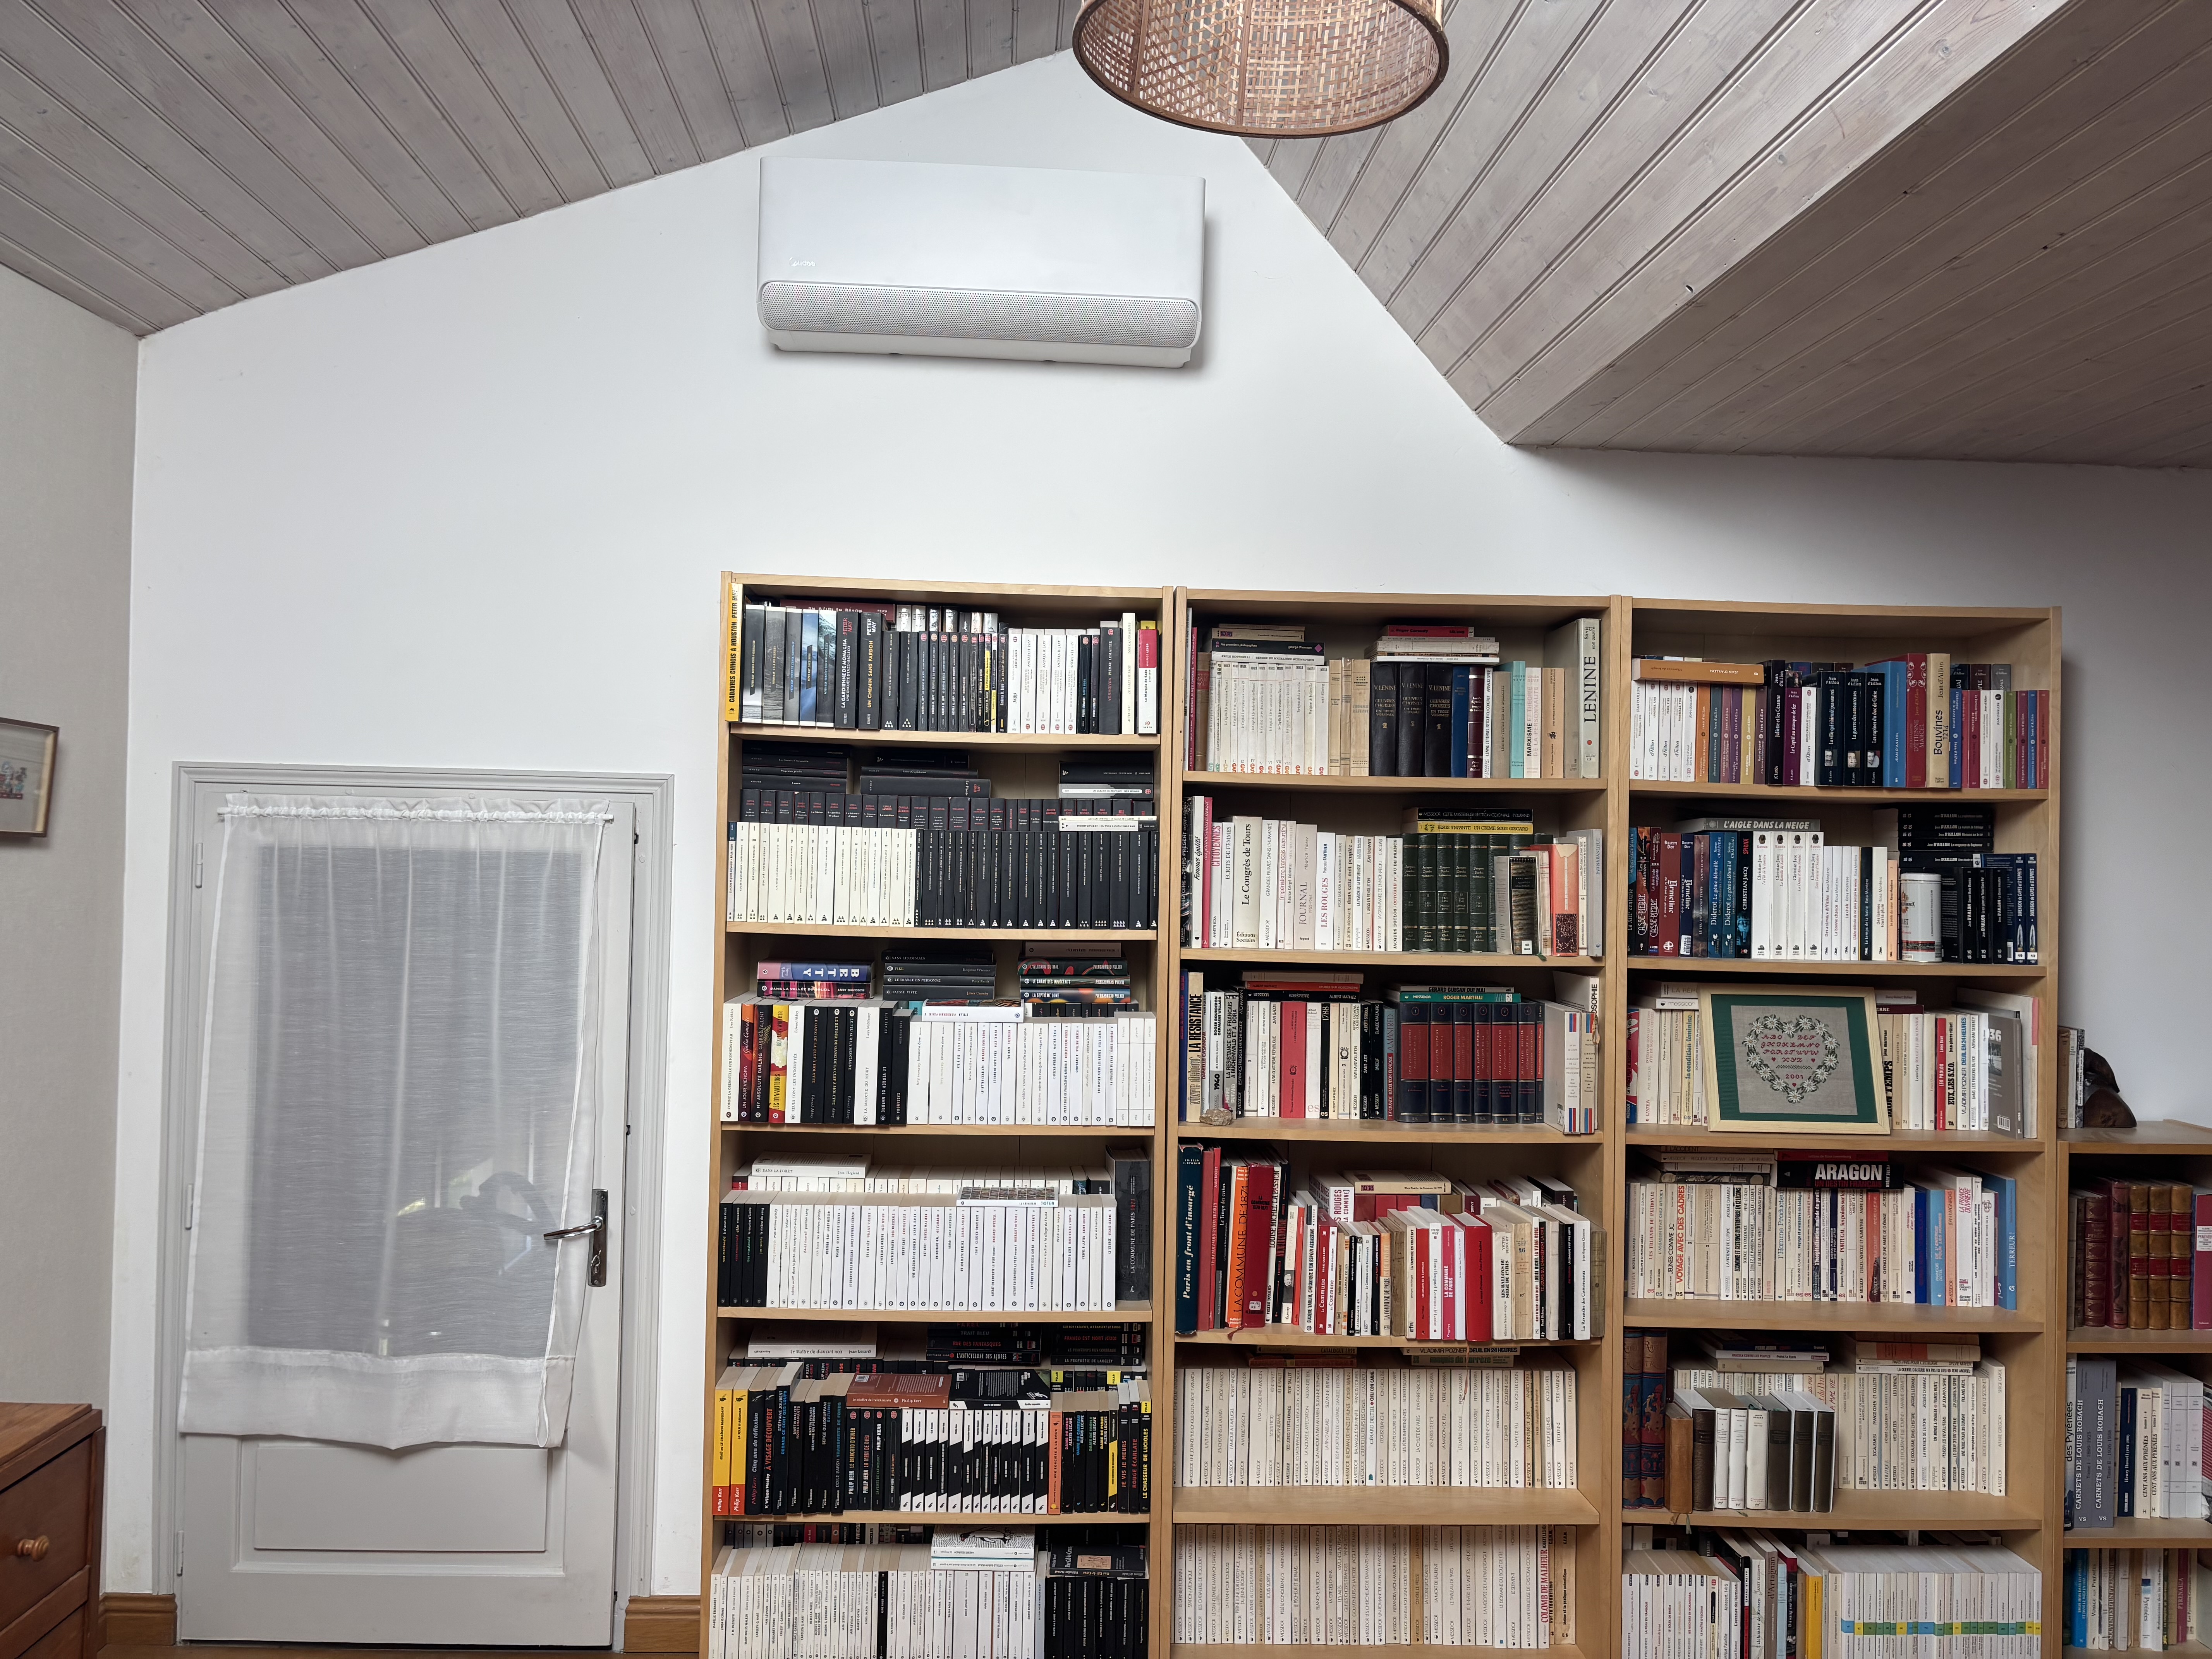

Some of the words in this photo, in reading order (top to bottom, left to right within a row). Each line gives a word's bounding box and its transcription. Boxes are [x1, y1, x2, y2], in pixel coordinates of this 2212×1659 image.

[1584, 656, 1596, 722] LENINE
[1933, 710, 1943, 755] Bouvines
[1211, 825, 1221, 866] CITOYENNES
[1243, 824, 1251, 846] Tours
[1243, 847, 1250, 856] de
[1242, 859, 1252, 892] Congrès
[1242, 894, 1250, 904] Le
[1299, 881, 1307, 924] JOURNAL
[1638, 893, 1647, 934] CASSE-PIERRE
[1650, 898, 1659, 936] CASSE-PIERRE
[803, 968, 859, 977] BETTY
[1189, 994, 1202, 1040] RESISTANCE
[1188, 1043, 1201, 1052] LA
[1989, 1029, 2001, 1041] 36
[1815, 1164, 1882, 1180] ARAGON
[1184, 1184, 1195, 1229] d'insurgé
[1183, 1231, 1194, 1257] front
[1185, 1259, 1191, 1271] au
[1183, 1273, 1191, 1298] Paris
[764, 1408, 773, 1442] DÉCOUVERT
[2065, 1401, 2074, 1443] Pyrénées
[2076, 1460, 2082, 1470] DE
[2096, 1459, 2102, 1470] DE
[1541, 1584, 1548, 1593] DE
